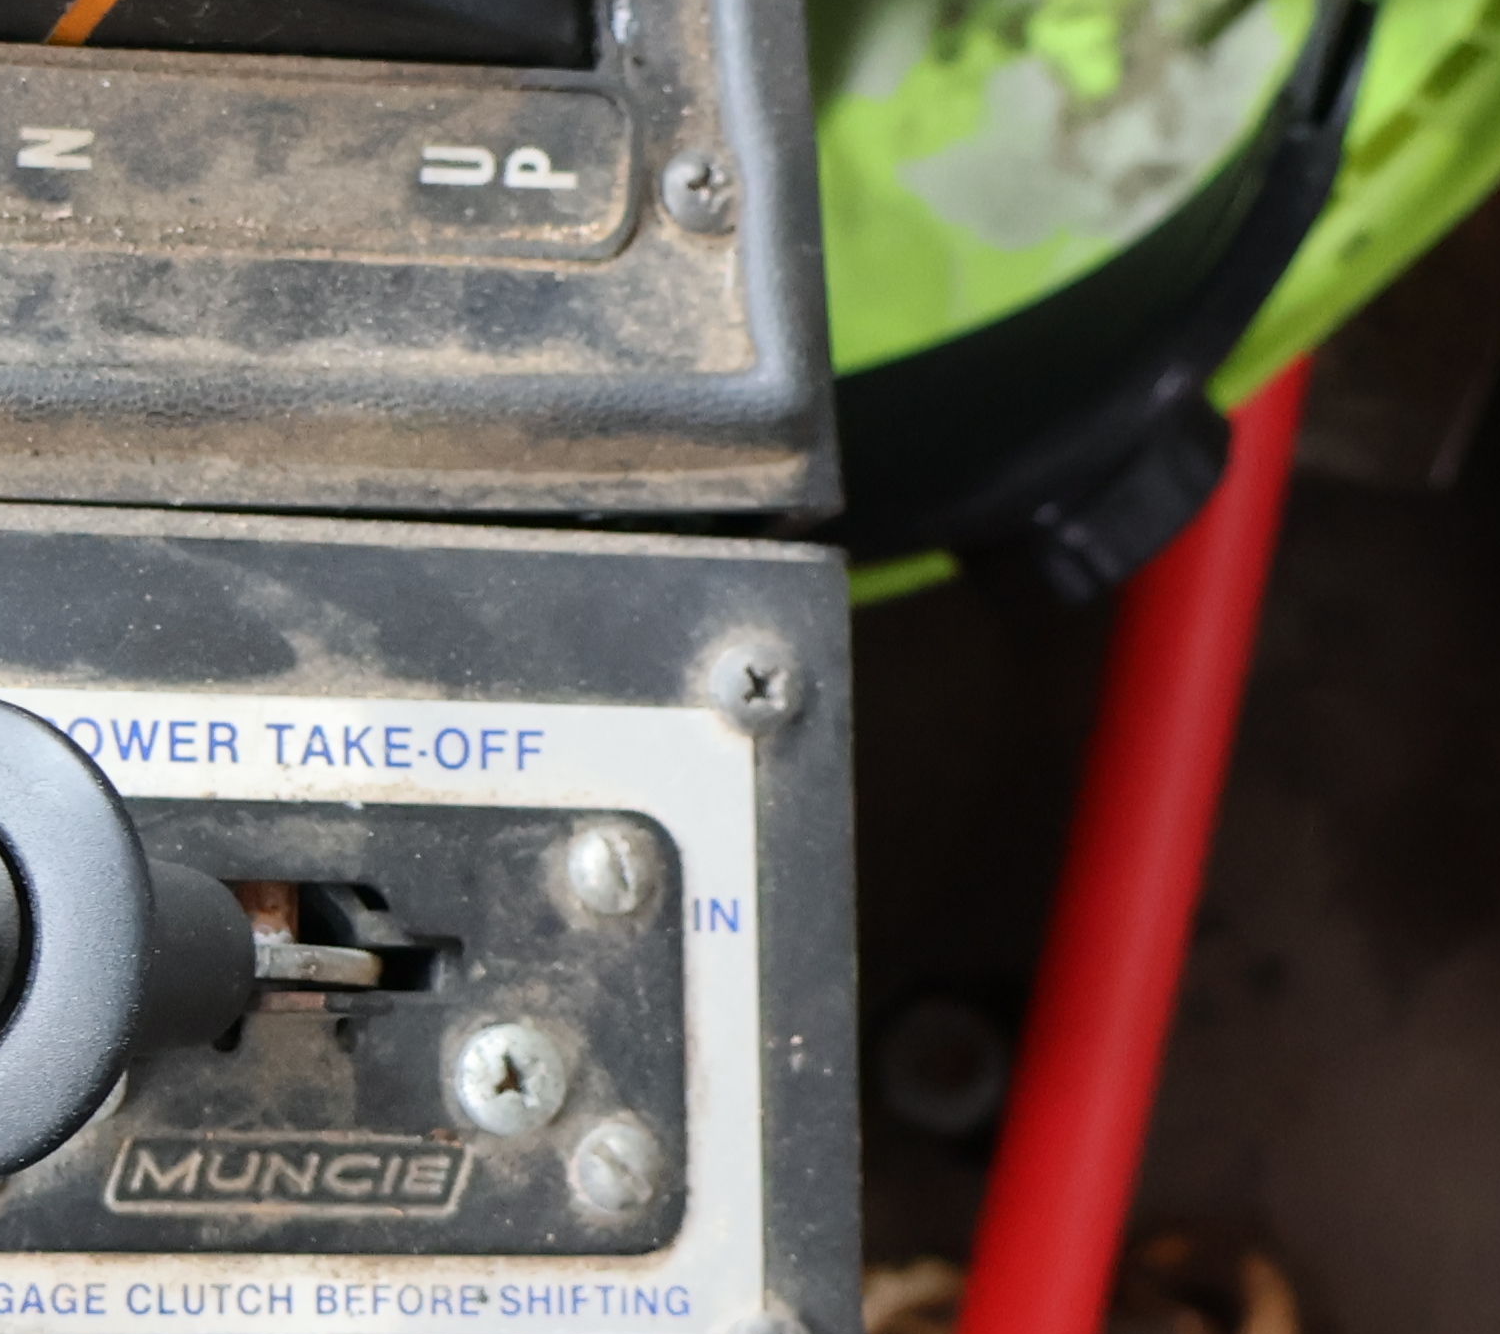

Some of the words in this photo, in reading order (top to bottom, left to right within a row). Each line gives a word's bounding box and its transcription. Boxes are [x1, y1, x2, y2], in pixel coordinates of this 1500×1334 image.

[16, 126, 95, 171] N
[420, 144, 579, 190] UP
[43, 716, 240, 765] OWER
[264, 722, 546, 771] TAKE-OFF
[693, 897, 741, 935] IN
[128, 1149, 451, 1197] MUNCIE
[126, 1282, 294, 1316] CLUTCH
[315, 1284, 481, 1317] BEFORE
[500, 1284, 692, 1318] SHIFTING
